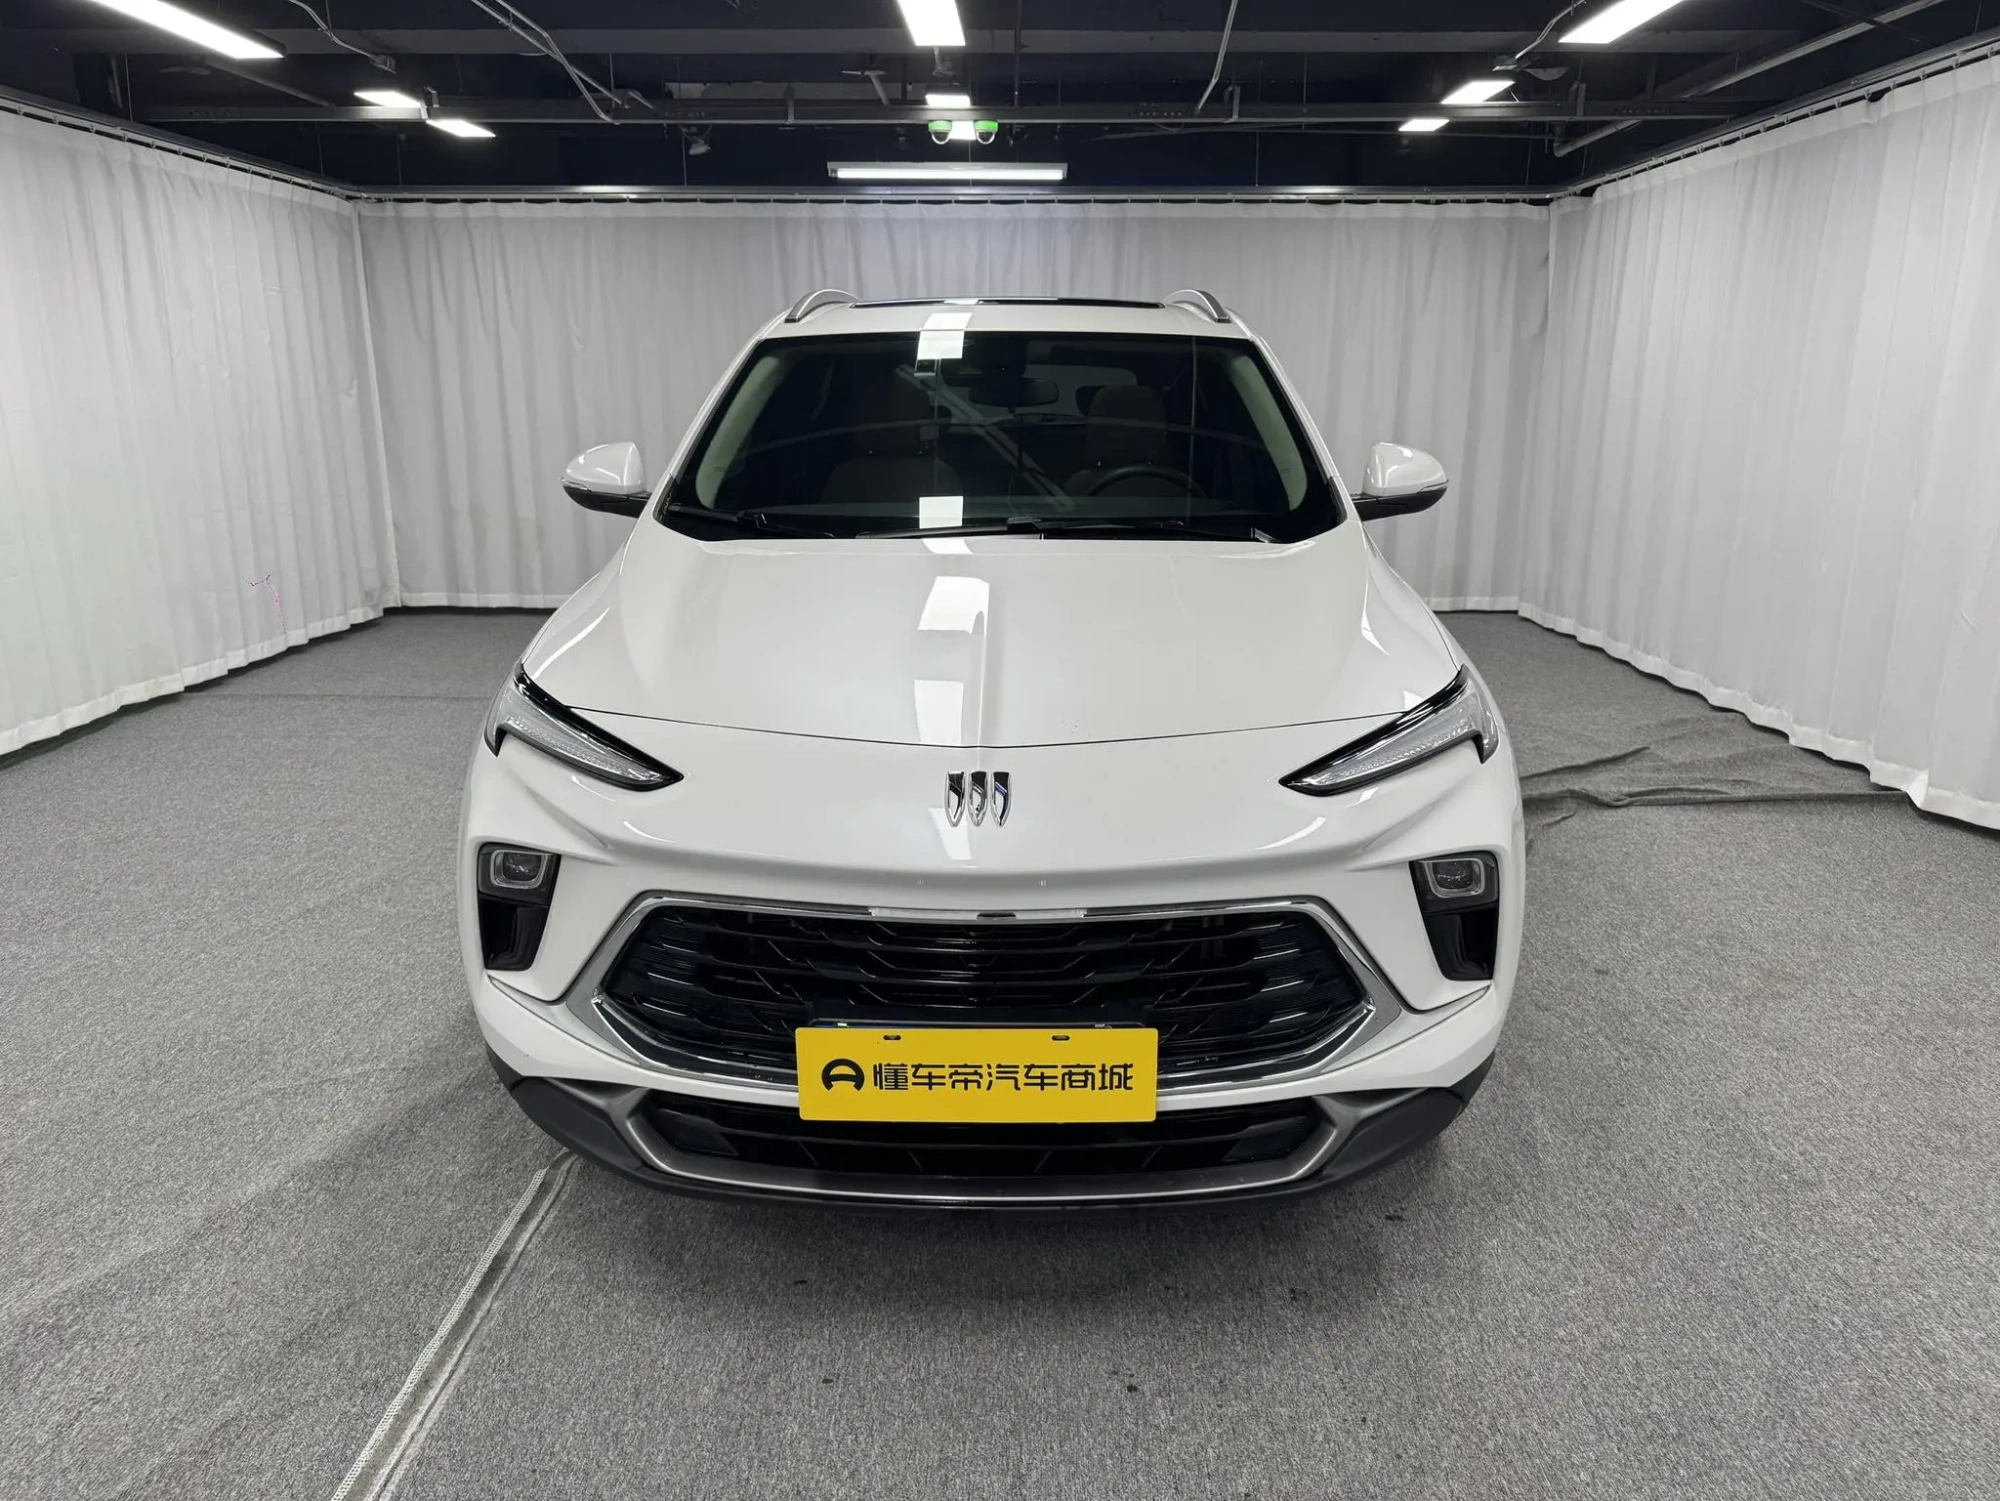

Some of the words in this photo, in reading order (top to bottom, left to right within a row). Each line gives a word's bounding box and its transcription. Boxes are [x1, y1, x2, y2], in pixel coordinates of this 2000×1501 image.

[873, 1063, 1133, 1091] 懂车帝汽车商城
